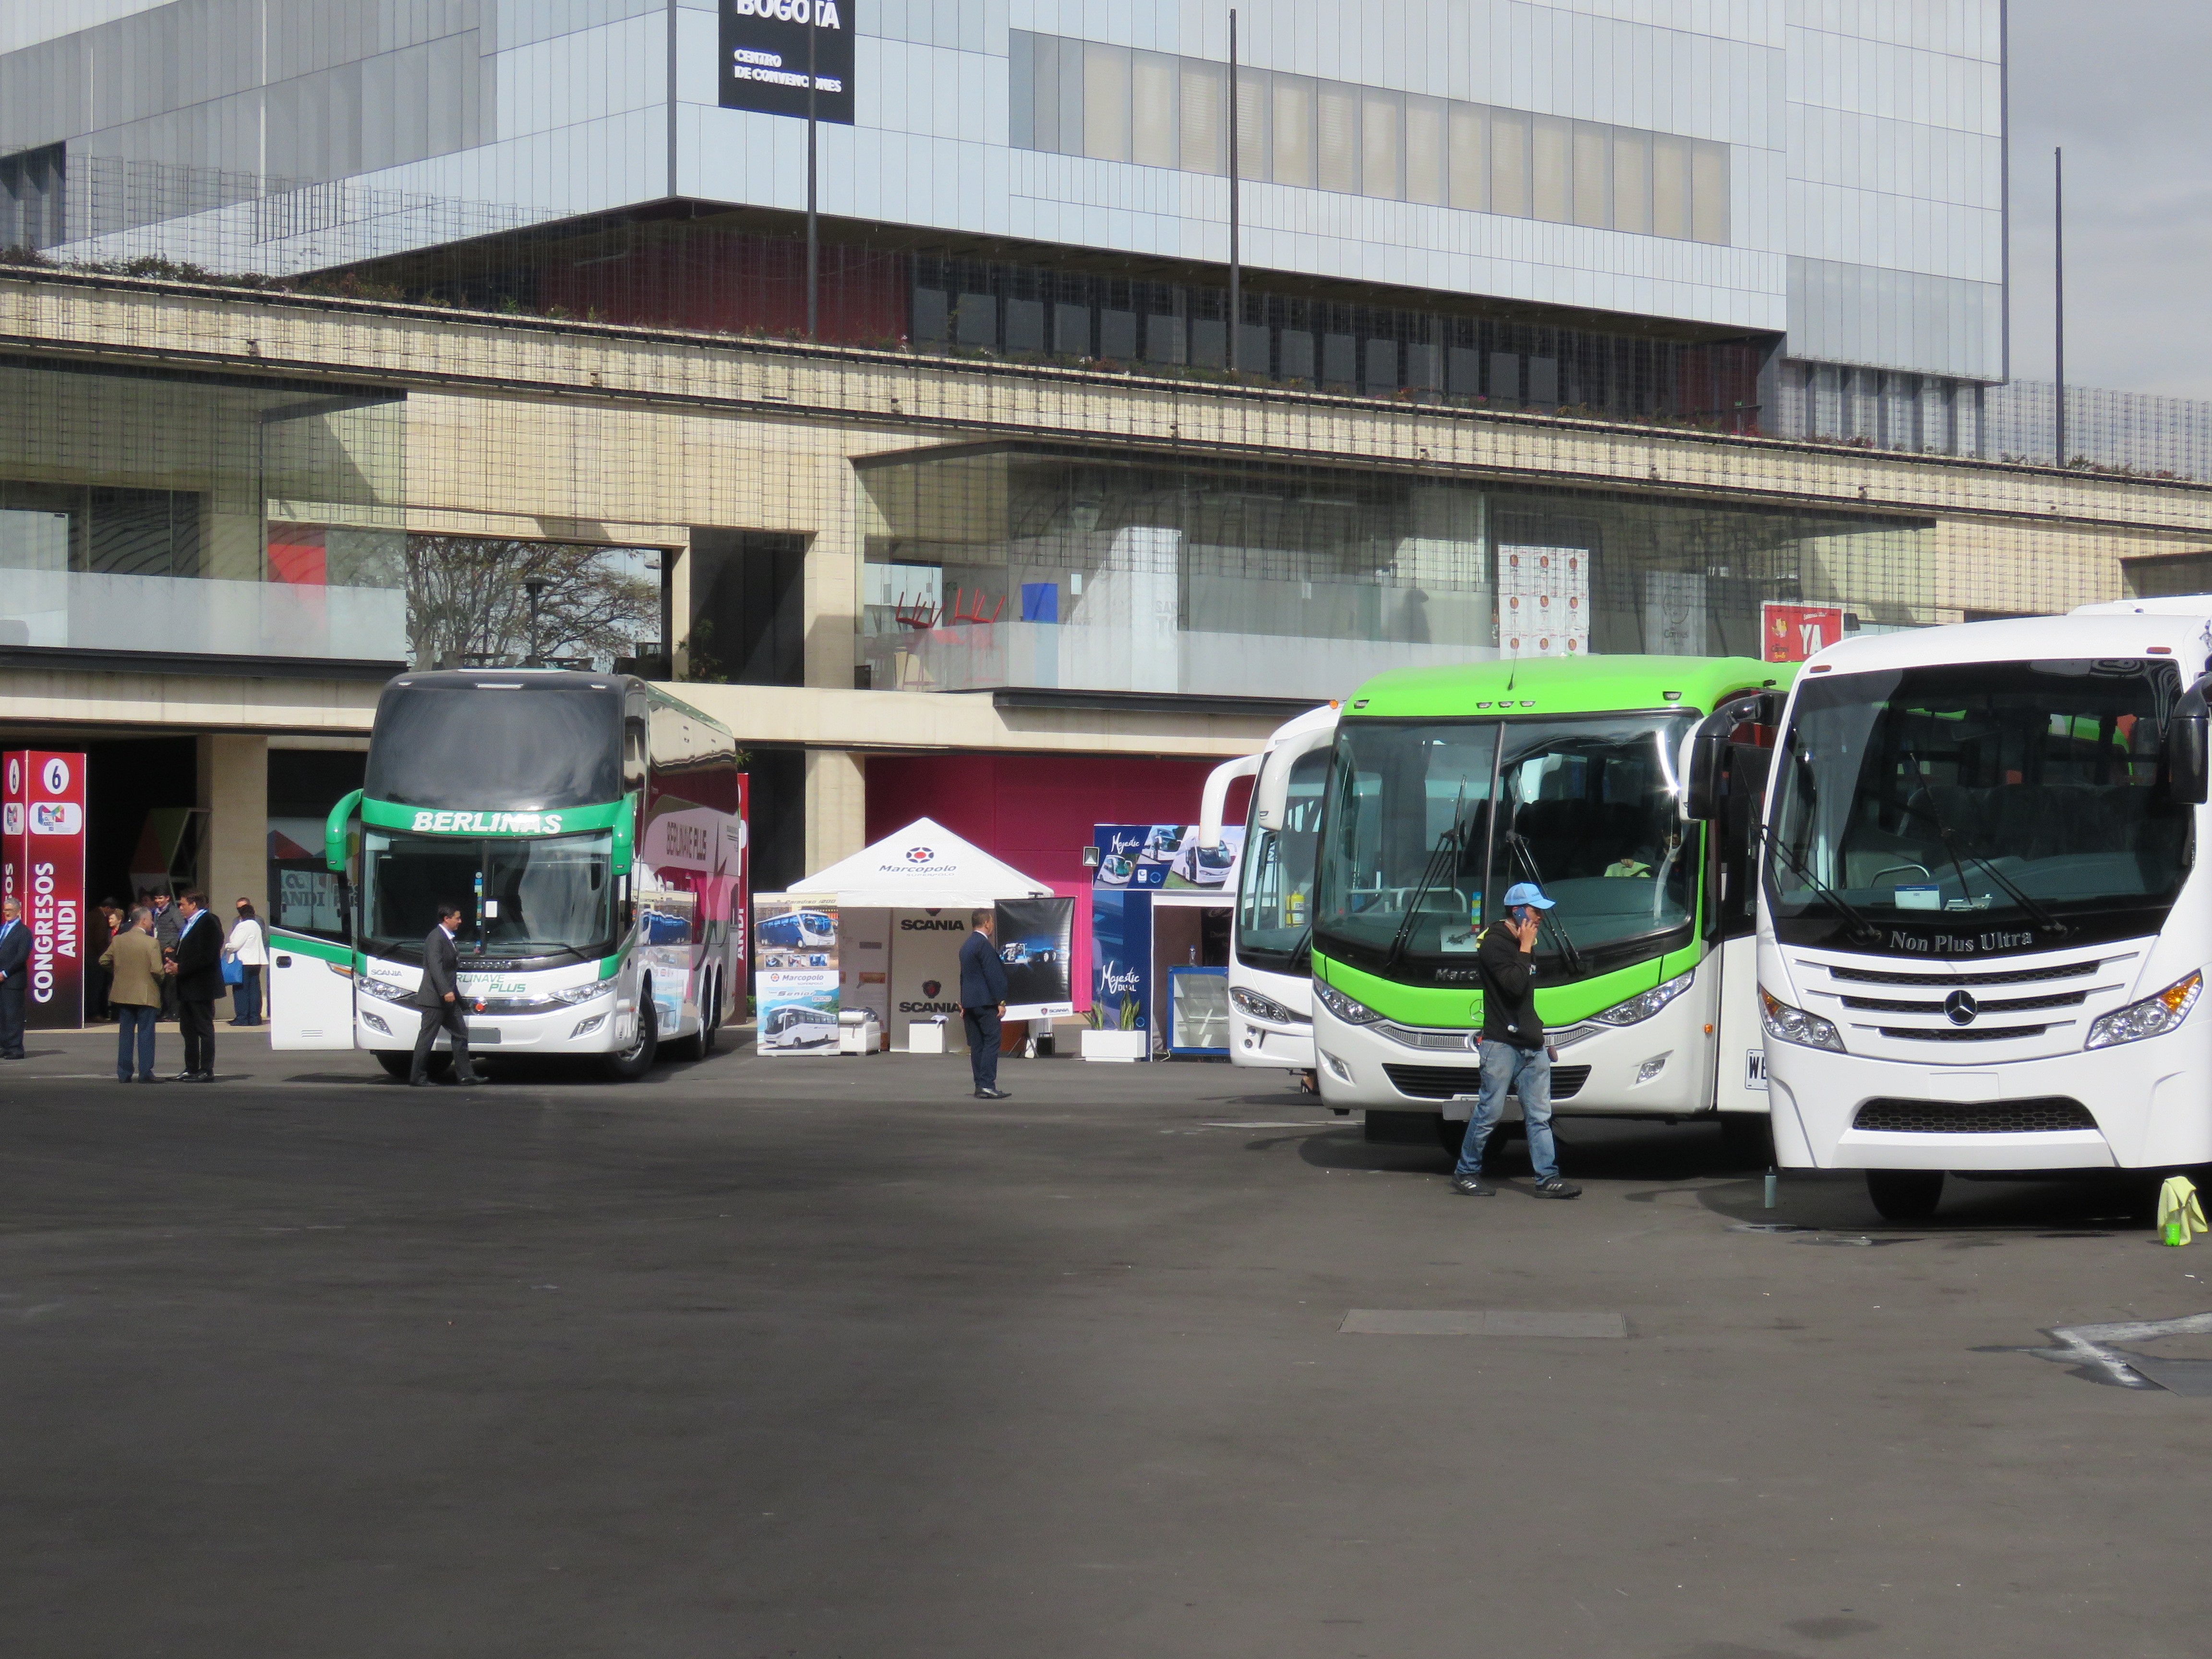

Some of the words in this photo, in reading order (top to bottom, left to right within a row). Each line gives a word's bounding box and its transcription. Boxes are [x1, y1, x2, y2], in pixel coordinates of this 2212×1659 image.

[734, 49, 782, 68] CENTRO
[734, 66, 752, 80] DE
[1799, 624, 1823, 655] YA
[12, 766, 16, 789] 6
[52, 766, 61, 789] 6
[411, 811, 563, 834] BERLINAS
[1111, 832, 1140, 854] Majestic
[878, 865, 957, 873] Marcopolo
[34, 863, 54, 1003] CONGRESOS
[58, 901, 76, 958] ANDI
[901, 919, 964, 931] SCANIA
[1889, 931, 1929, 952] Non
[1934, 936, 1974, 952] Plus
[1980, 931, 2033, 951] Ultra
[488, 983, 527, 993] PLUS
[782, 974, 824, 982] Marcopolo
[1100, 960, 1140, 995] Majestic
[899, 1001, 962, 1013] SCANIA
